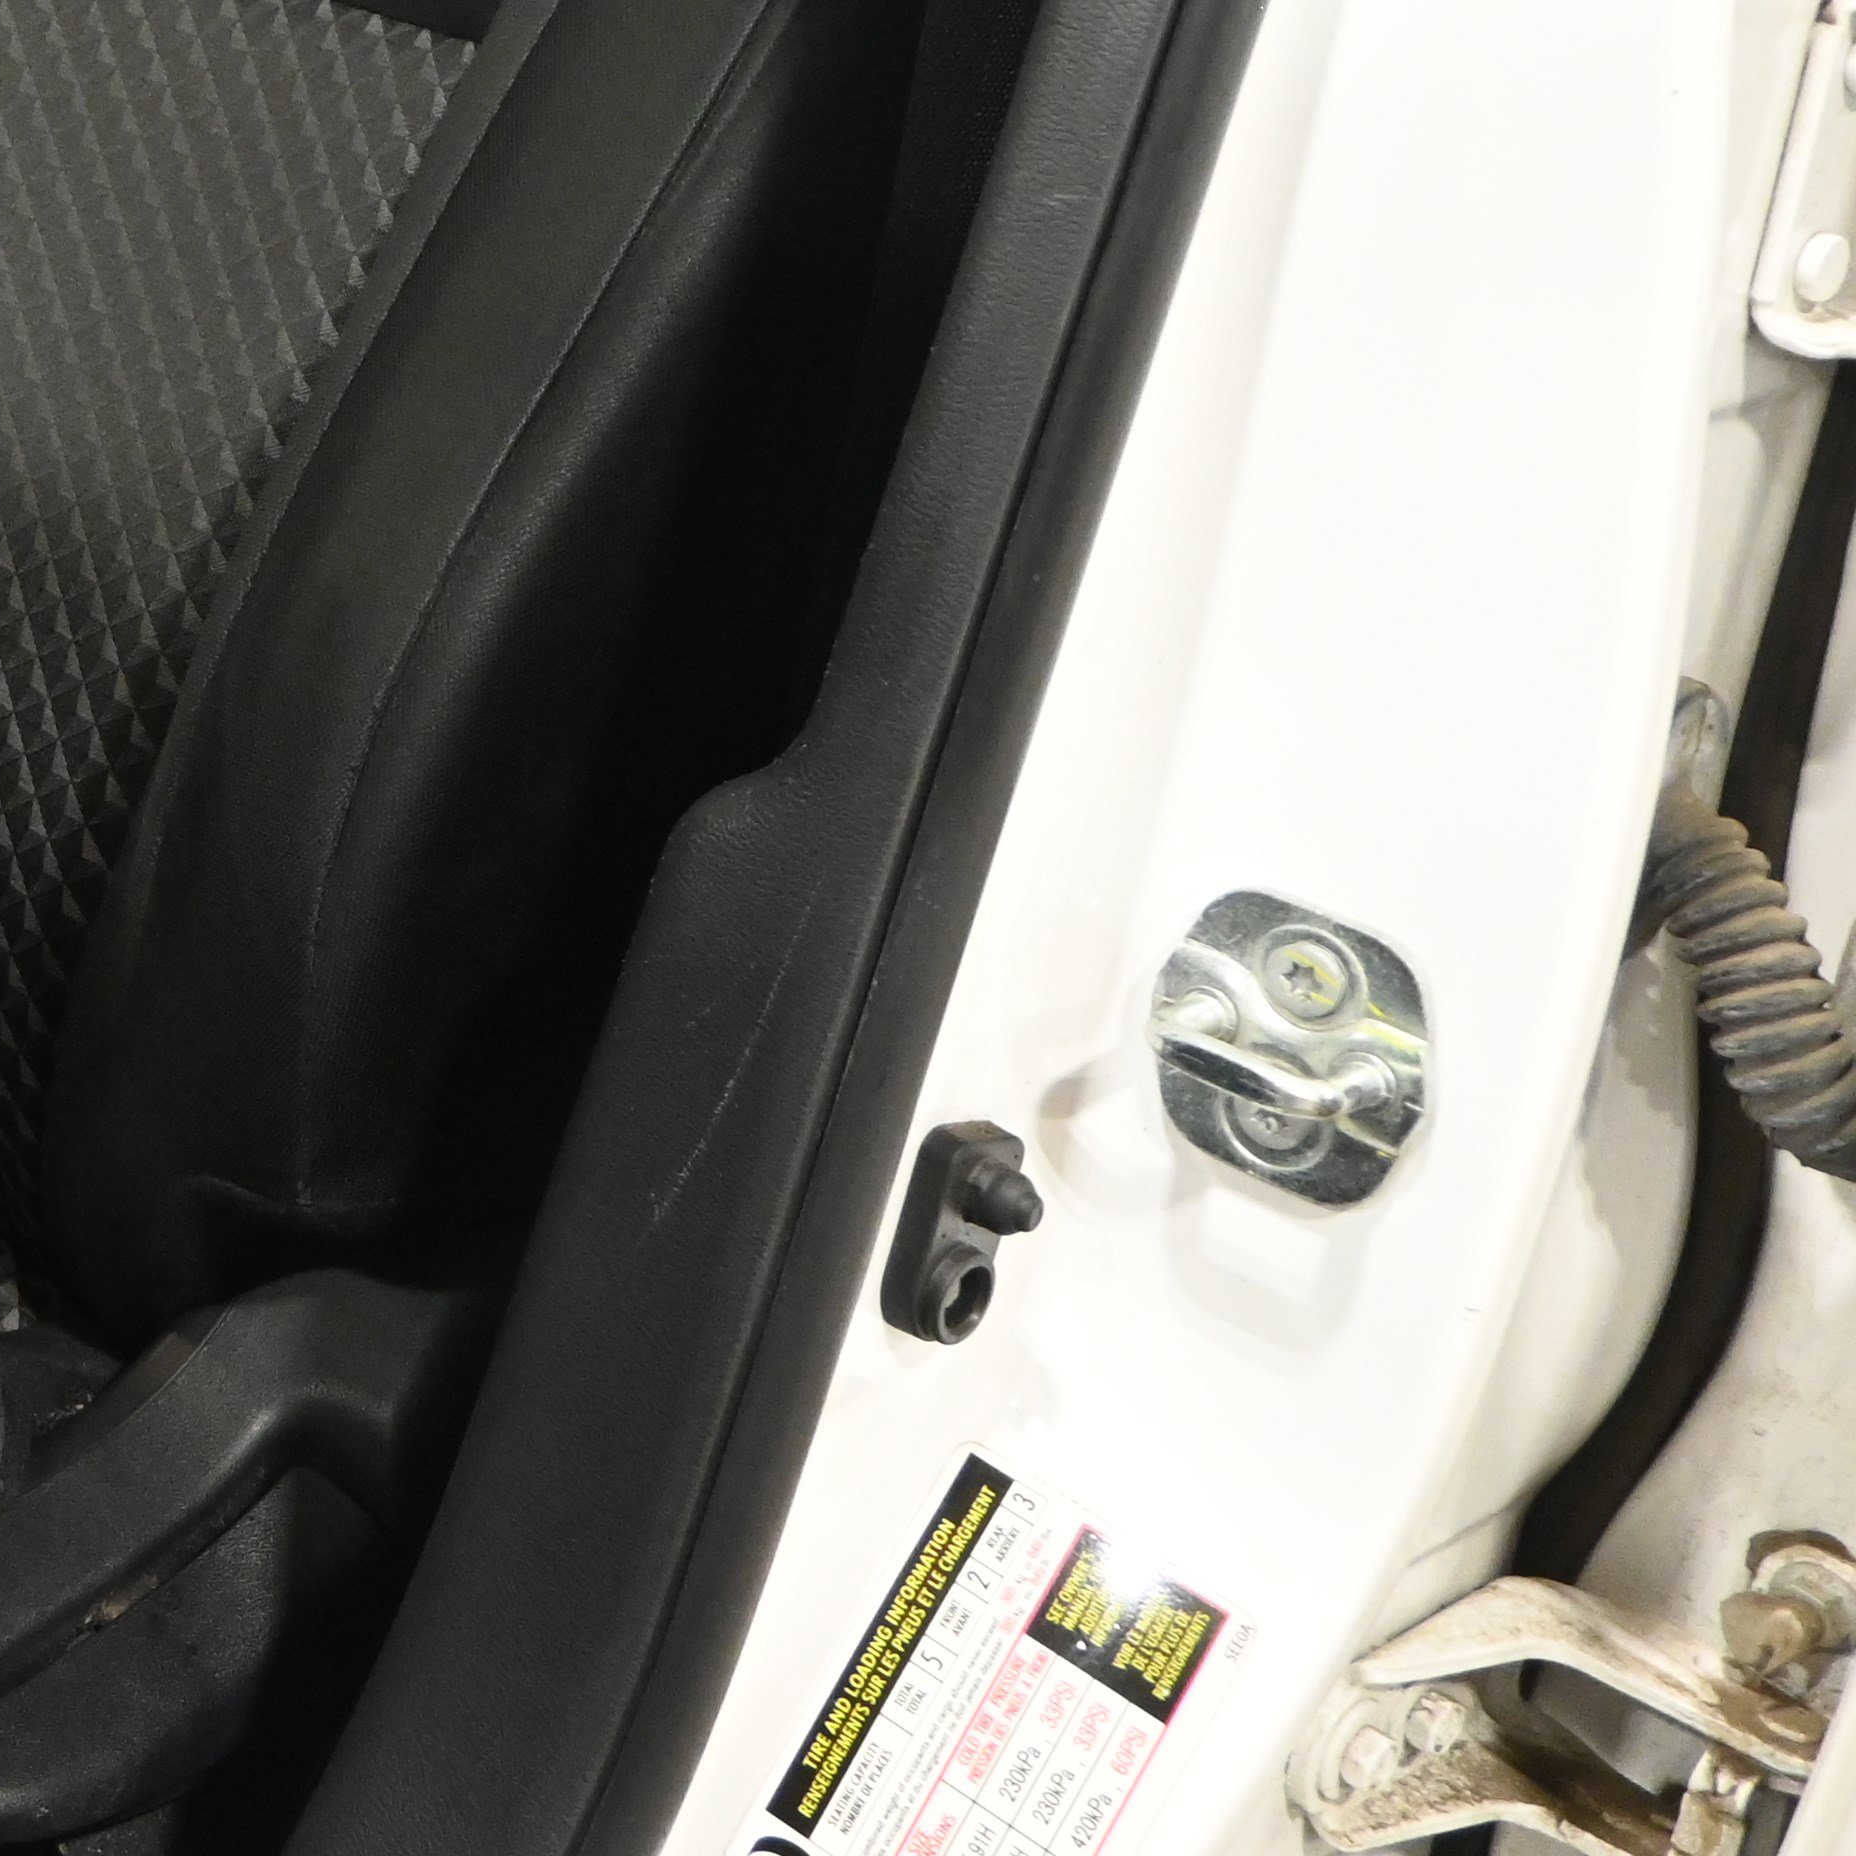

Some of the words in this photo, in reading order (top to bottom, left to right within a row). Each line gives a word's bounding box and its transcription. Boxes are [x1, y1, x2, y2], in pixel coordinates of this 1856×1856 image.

[1010, 1490, 1037, 1513] 3
[935, 1482, 997, 1574] CHARGEMENT
[915, 1585, 938, 1608] ET
[925, 1568, 947, 1591] LE
[965, 1568, 991, 1590] 2
[890, 1603, 927, 1653] PNEUS
[949, 1605, 973, 1638] AVANT
[1044, 1596, 1069, 1625] SEE
[801, 1731, 832, 1770] TIRE
[821, 1694, 853, 1736] AND
[842, 1622, 895, 1698] LOADING
[883, 1516, 956, 1626] INFORMATION
[918, 1648, 945, 1671] 5
[1111, 1640, 1137, 1671] VOIR
[1125, 1627, 1144, 1646] LE
[1141, 1649, 1170, 1685] POUR
[1157, 1623, 1184, 1655] PLUS
[1172, 1607, 1193, 1628] DE
[1149, 1608, 1213, 1702] RENSEIGNEMENTS
[876, 1648, 902, 1677] LES
[1130, 1651, 1150, 1672] DE
[860, 1673, 887, 1706] SUR
[892, 1679, 915, 1708] TOTAL
[905, 1687, 927, 1716] TOTAL
[995, 1741, 1042, 1803] 230kPa
[1035, 1676, 1079, 1730] 33PSI
[796, 1701, 873, 1819] RENSEIGNEMENTS
[866, 1746, 894, 1783] PLACES
[1029, 1763, 1076, 1825] 230kPa
[1069, 1698, 1113, 1753] 33PSI
[825, 1784, 857, 1828] SEATING
[848, 1739, 882, 1787] CAPACITY
[859, 1781, 874, 1797] DE
[1065, 1787, 1114, 1851] 420kPa
[1106, 1723, 1150, 1777] 60PSI
[837, 1795, 867, 1836] NOMBRE
